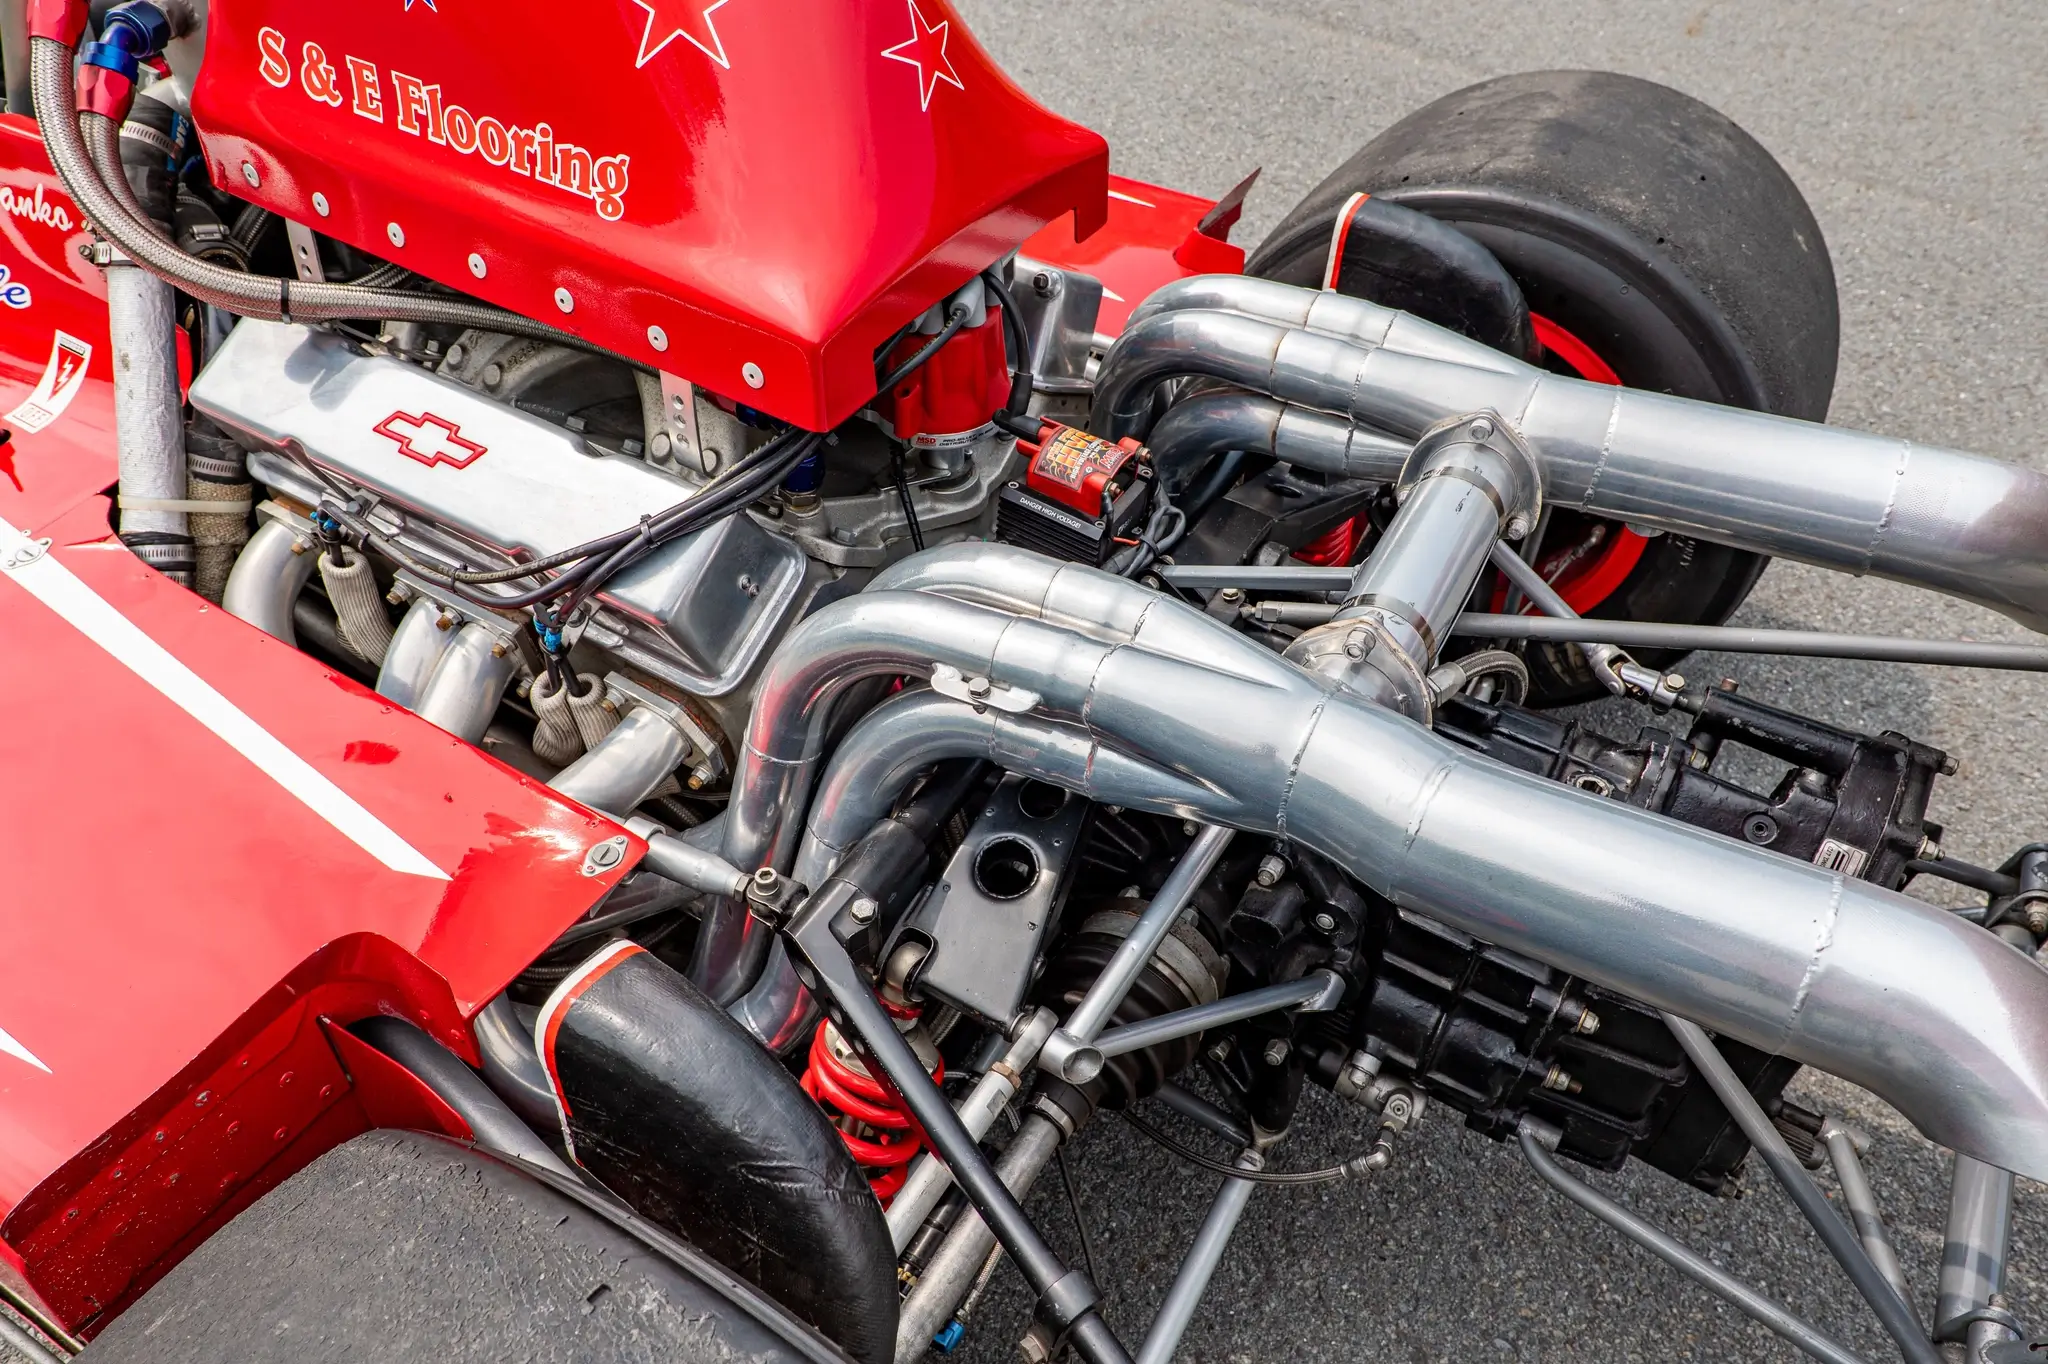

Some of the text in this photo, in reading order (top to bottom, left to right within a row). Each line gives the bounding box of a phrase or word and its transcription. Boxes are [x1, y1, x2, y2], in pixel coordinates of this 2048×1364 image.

[257, 26, 631, 221] S & E Flooring
[916, 436, 937, 444] MSD
[1020, 497, 1082, 529] DANGER HIGH VOLTAGE!
